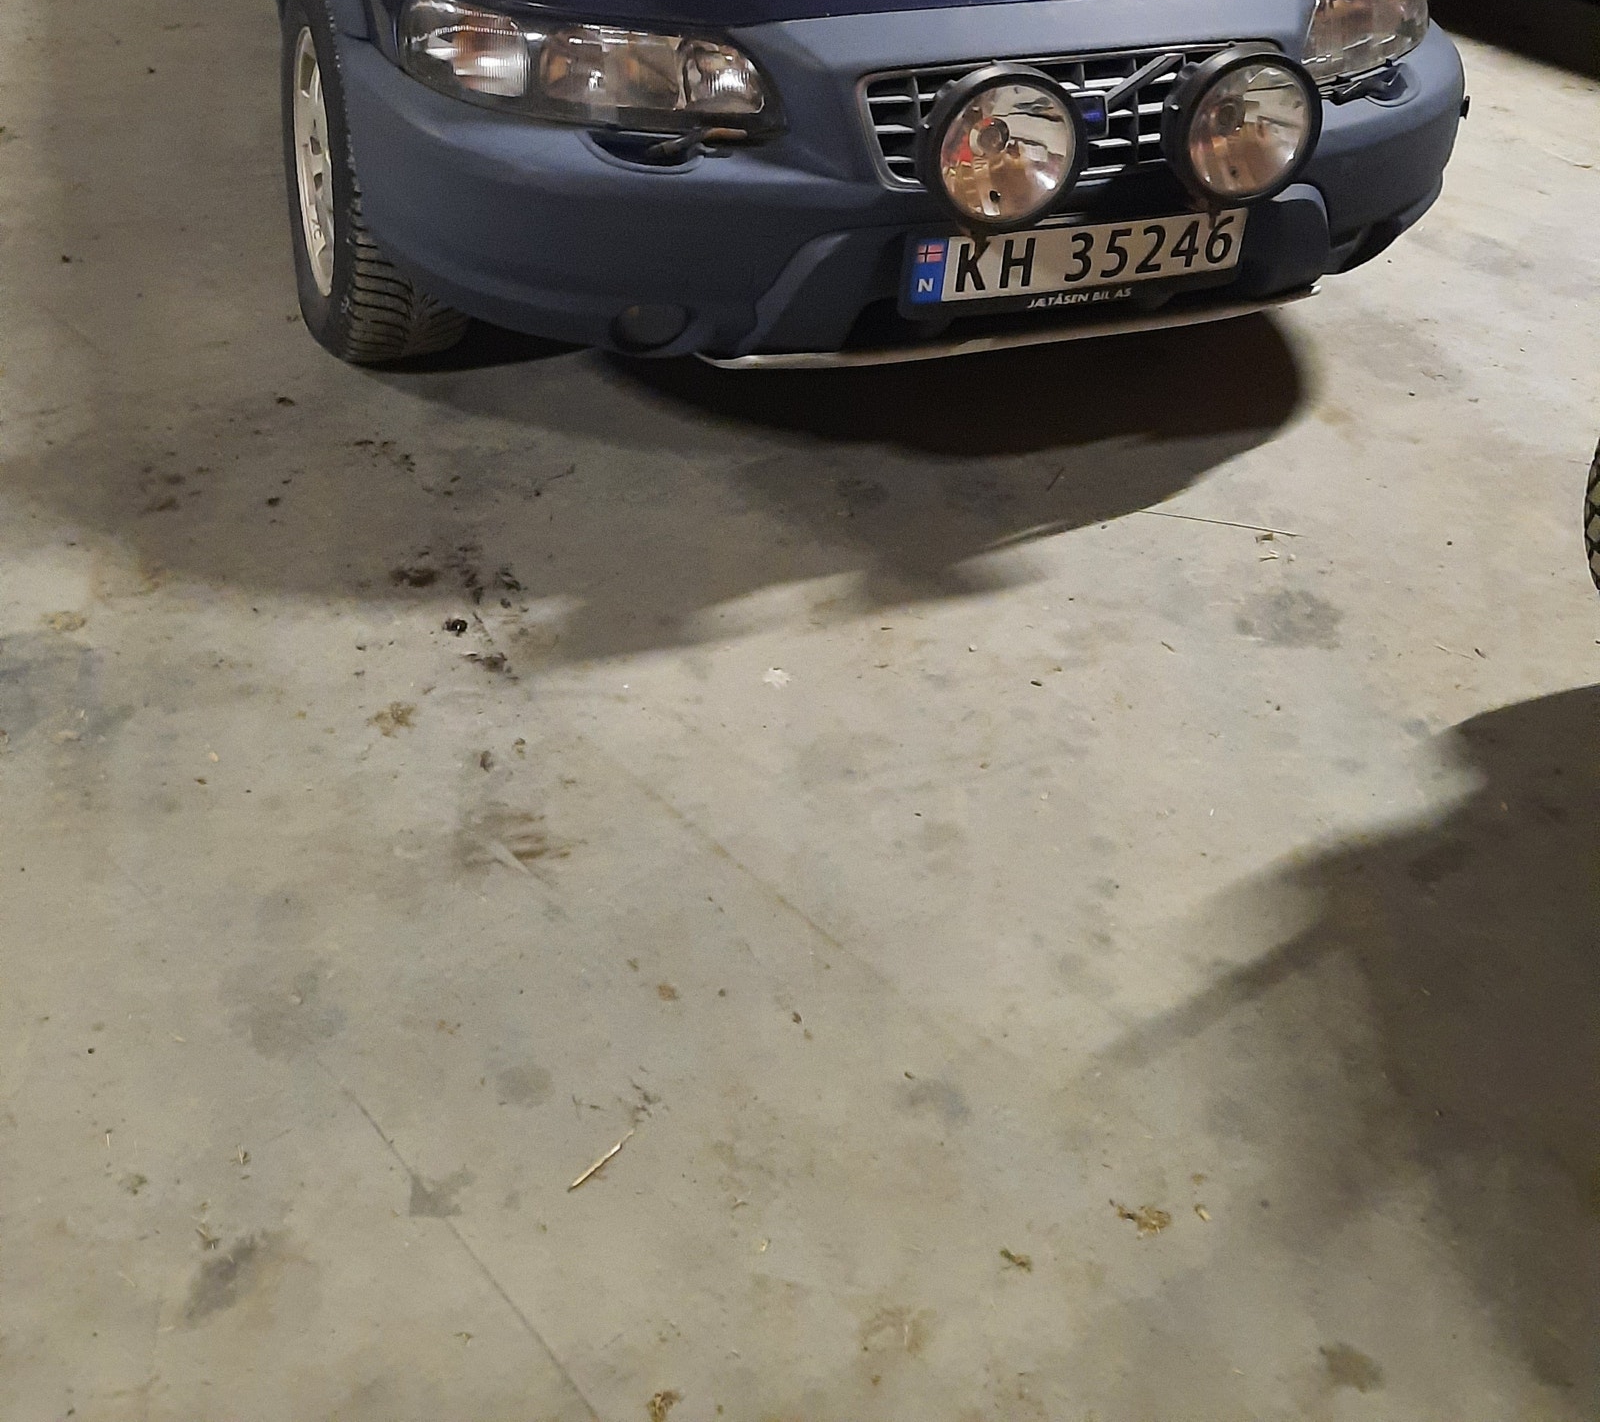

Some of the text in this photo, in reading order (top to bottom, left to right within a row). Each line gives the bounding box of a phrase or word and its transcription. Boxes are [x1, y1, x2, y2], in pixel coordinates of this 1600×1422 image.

[955, 216, 1235, 292] KH 35246
[917, 278, 934, 293] N
[1114, 287, 1132, 299] AS
